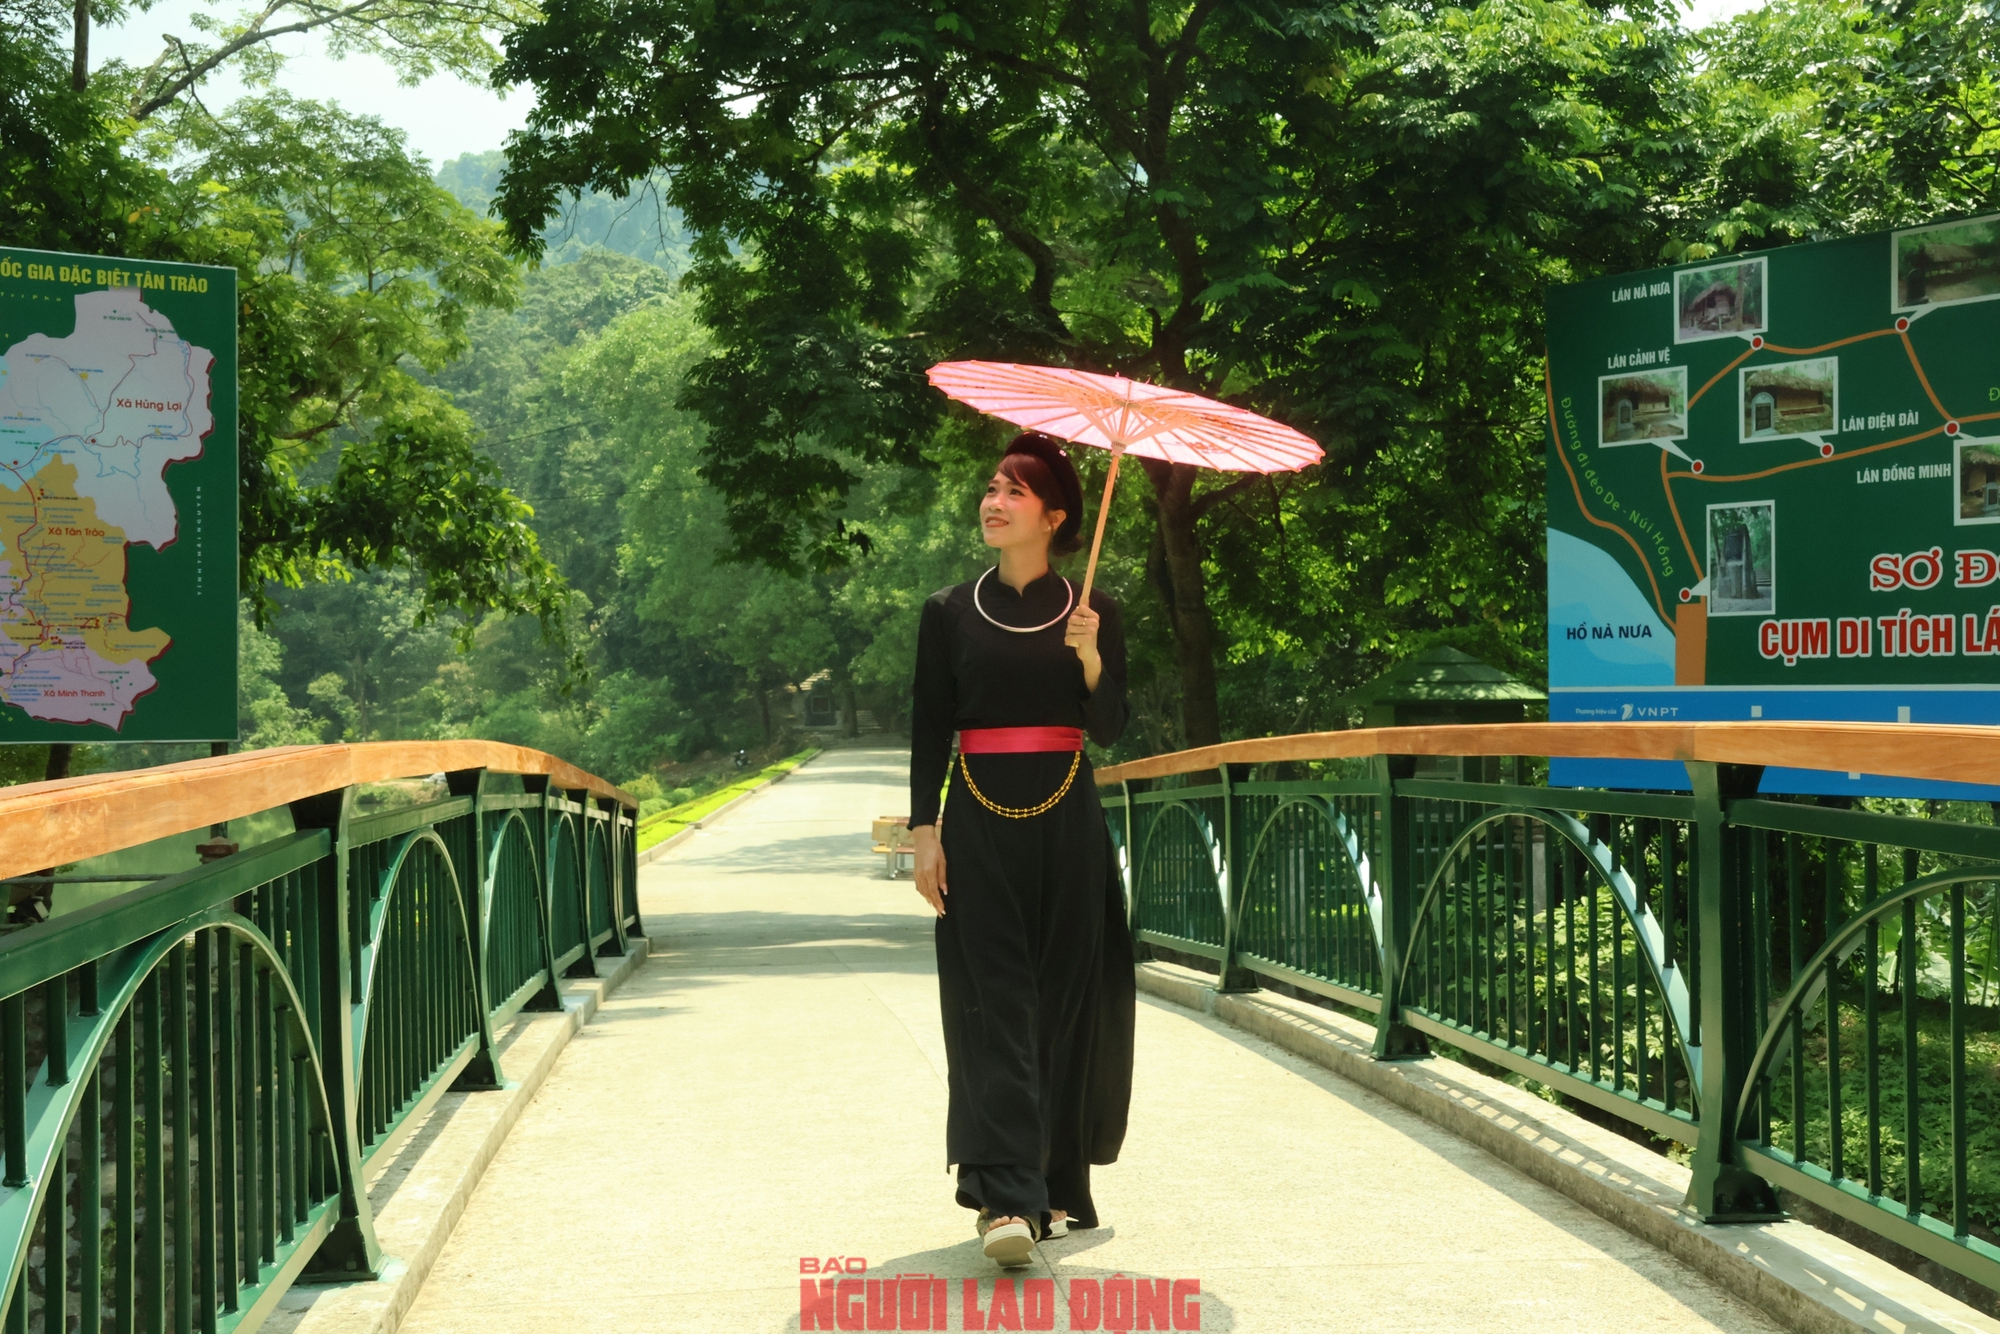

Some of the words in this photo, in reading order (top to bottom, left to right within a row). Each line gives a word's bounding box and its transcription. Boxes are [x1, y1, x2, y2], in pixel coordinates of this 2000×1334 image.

[27, 263, 55, 281] GIA
[59, 264, 92, 287] ĐẶC
[96, 267, 131, 290] BIỆT
[134, 270, 165, 290] TÂN
[169, 274, 208, 293] TRÀO
[1612, 287, 1631, 303] LÁN
[1633, 283, 1648, 300] NÀ
[1649, 281, 1671, 297] NƯA
[1608, 353, 1627, 369] LÁN
[1629, 348, 1656, 367] CẢNH
[1658, 346, 1671, 364] VỆ
[117, 398, 132, 408] Xã
[135, 399, 164, 412] Hùng
[167, 401, 182, 412] Lợi
[1842, 416, 1865, 432] LÁN
[1867, 412, 1896, 431] ĐIỆN
[1898, 409, 1919, 426] ĐÀI
[1561, 397, 1581, 450] Đường
[1577, 453, 1590, 468] đi
[1585, 469, 1603, 495] đèo
[1603, 491, 1620, 511] De
[1629, 510, 1654, 533] Núi
[1856, 467, 1879, 484] LÁN
[1882, 463, 1915, 482] ĐỒNG
[1918, 463, 1951, 479] MINH
[48, 527, 62, 535] Xã
[65, 527, 82, 536] Tân
[85, 528, 105, 537] Trào
[1870, 546, 1943, 591] SƠ
[1954, 549, 2000, 588] Đ
[1566, 621, 1587, 640] HỒ
[1592, 622, 1614, 639] NÀ
[1618, 624, 1652, 638] NƯA
[1759, 618, 1831, 666] CỤM
[1837, 617, 1872, 657] DI
[1877, 607, 1955, 657] TÍCH
[1637, 707, 1679, 717] VNPT
